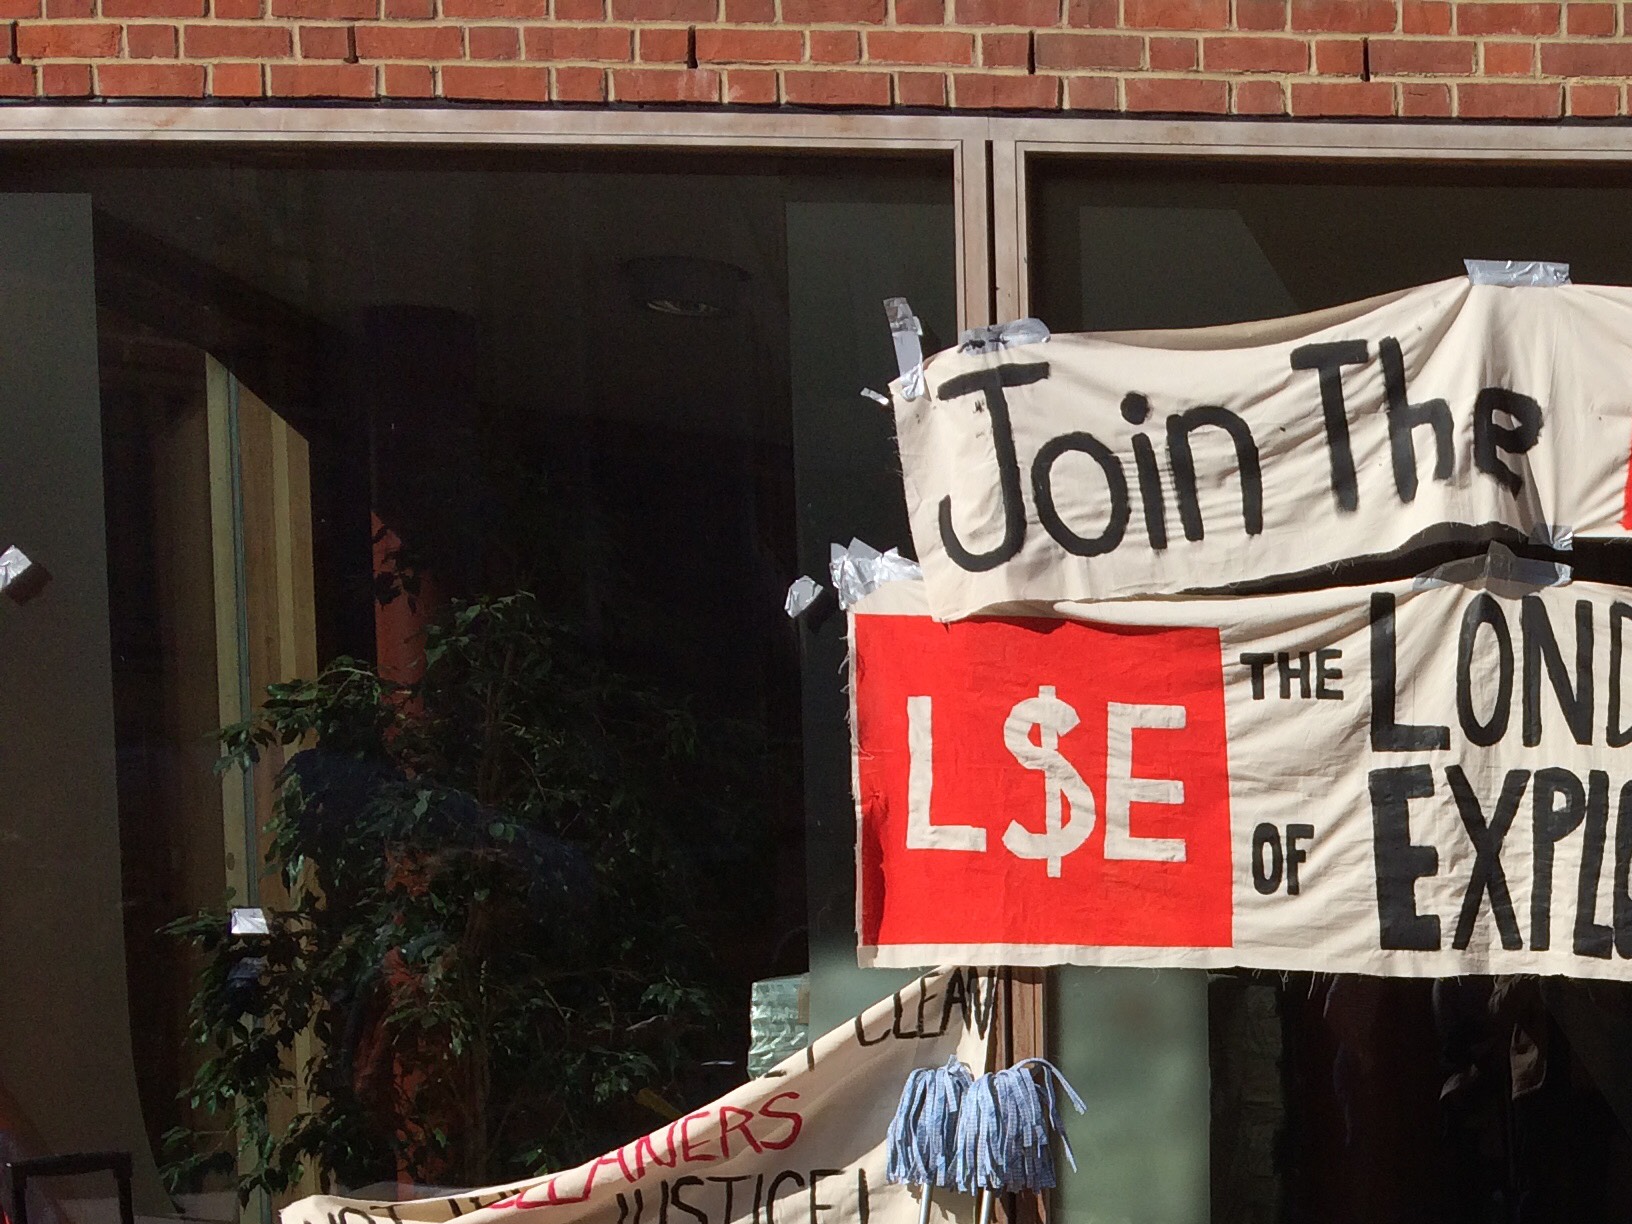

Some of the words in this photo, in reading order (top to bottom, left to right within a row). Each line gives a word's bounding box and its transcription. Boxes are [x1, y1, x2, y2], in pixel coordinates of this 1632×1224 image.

[937, 361, 1262, 573] Join
[1290, 336, 1543, 513] The
[1240, 648, 1344, 701] THE
[1252, 822, 1315, 896] OF
